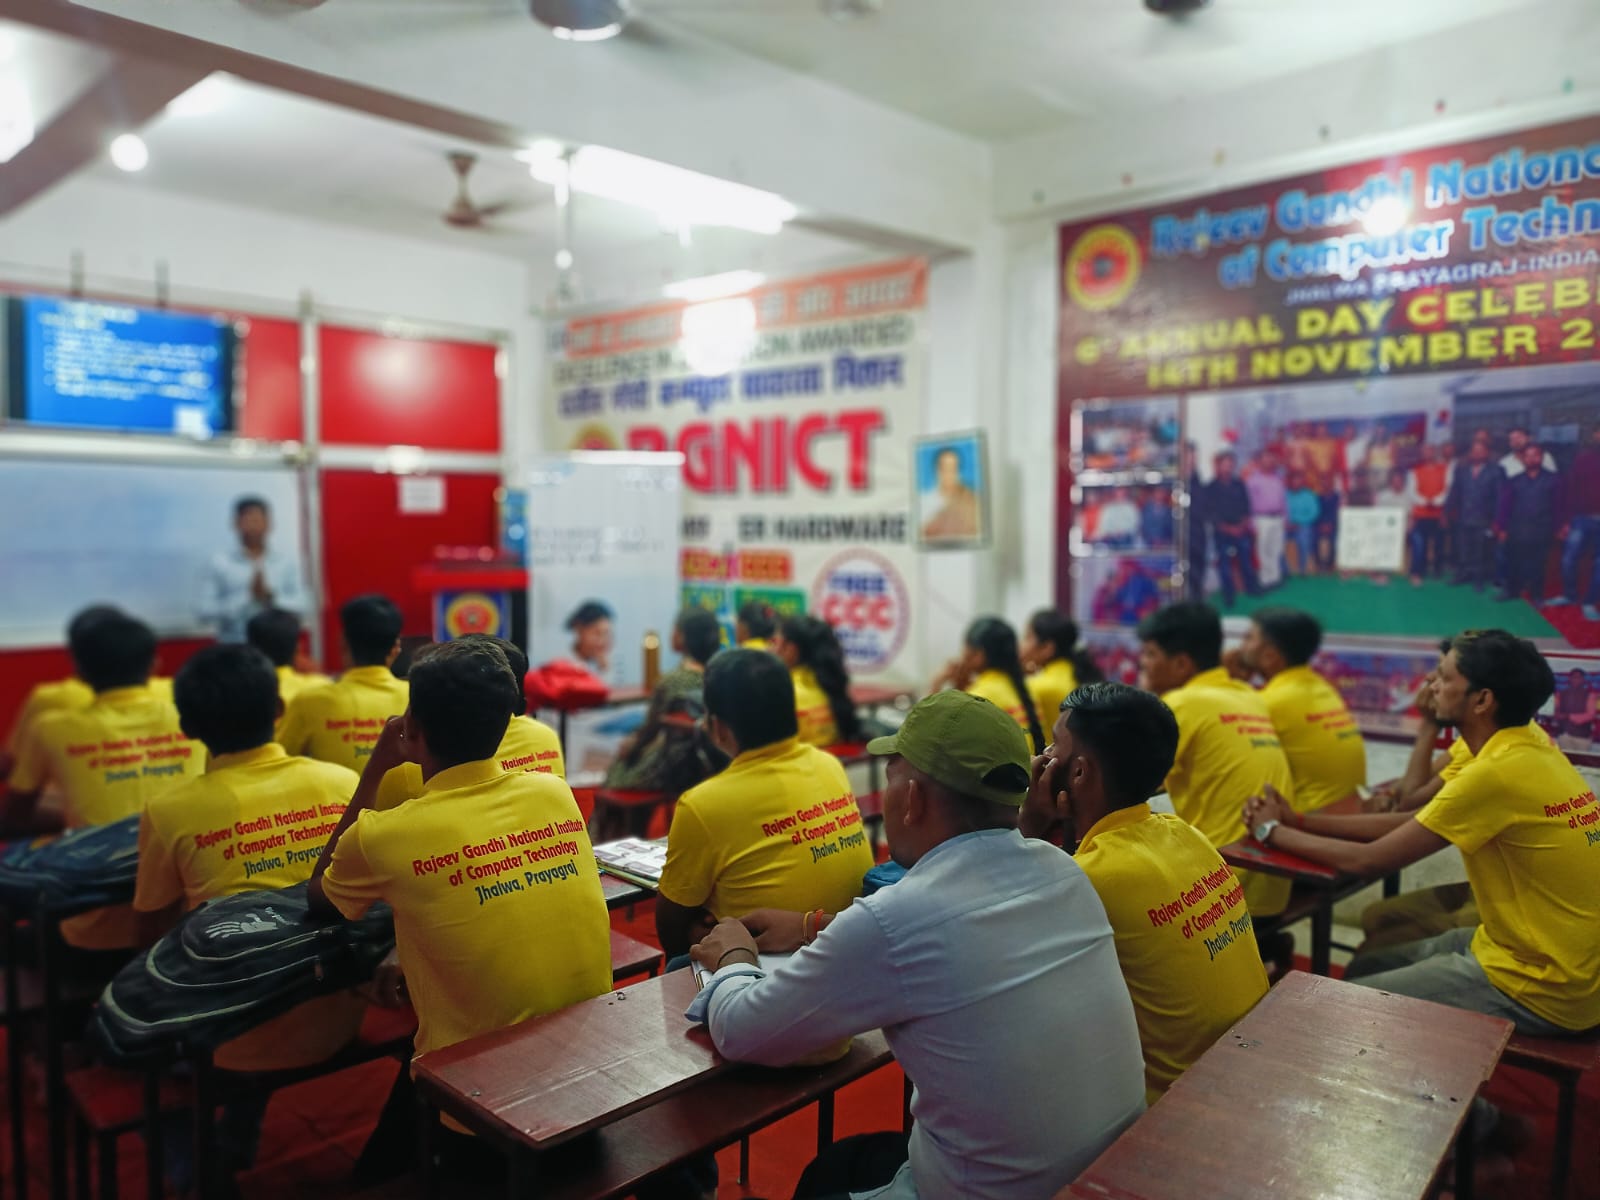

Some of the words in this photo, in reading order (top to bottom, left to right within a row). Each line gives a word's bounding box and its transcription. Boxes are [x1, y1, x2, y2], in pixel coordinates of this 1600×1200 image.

[1217, 242, 1260, 290] of
[1263, 218, 1454, 281] Computer
[1119, 313, 1284, 360] ANNUAL
[1297, 297, 1394, 338] DAY
[1406, 274, 1600, 326] CELEB
[1251, 323, 1538, 380] NOVEMBER
[194, 828, 232, 849] Rajeev
[235, 816, 272, 835] Gandhi
[274, 804, 317, 827] National
[762, 815, 797, 837] Rajeev
[796, 804, 826, 822] Gandhi
[1544, 802, 1571, 817] Rajeev
[1568, 815, 1578, 829] of
[222, 844, 235, 860] of
[237, 833, 286, 855] Computer
[412, 851, 460, 876] Rajeev
[462, 836, 507, 859] Gandhi
[506, 823, 555, 848] National
[555, 818, 583, 835] Institute
[791, 830, 802, 846] of
[802, 821, 837, 840] Computer
[243, 856, 285, 879] Jhalwa,
[449, 869, 464, 887] of
[466, 853, 522, 880] Computer
[523, 840, 579, 864] Technology
[475, 878, 524, 906] Jhalwa,
[524, 859, 579, 887] Prayagraj
[1147, 899, 1185, 927] Rajeev
[1180, 879, 1208, 907] Gandhi
[1182, 919, 1194, 939] of
[1192, 901, 1226, 932] Computer
